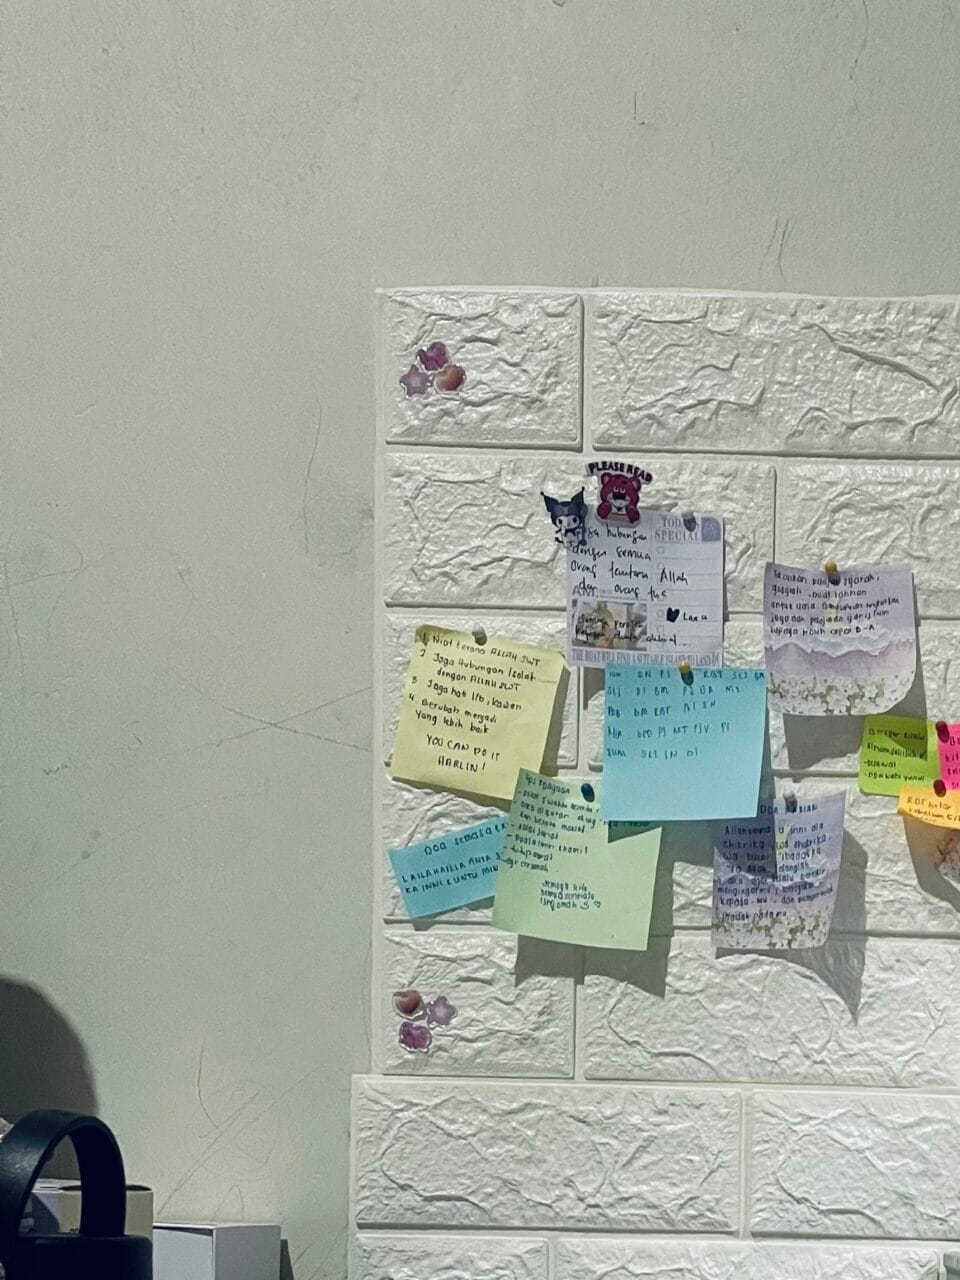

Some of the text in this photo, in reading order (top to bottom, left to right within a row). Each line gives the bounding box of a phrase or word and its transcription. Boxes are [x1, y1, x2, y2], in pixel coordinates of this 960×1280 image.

[589, 461, 652, 483] PLEASE READ
[660, 568, 689, 585] Allah
[491, 648, 517, 661] ALLAH
[520, 655, 541, 667] SWT
[443, 716, 463, 729] lebih
[470, 723, 489, 734] baik
[427, 733, 501, 761] YOU CAN DO IT
[760, 805, 778, 815] DOA
[424, 842, 447, 855] DOA
[405, 886, 419, 894] KA
